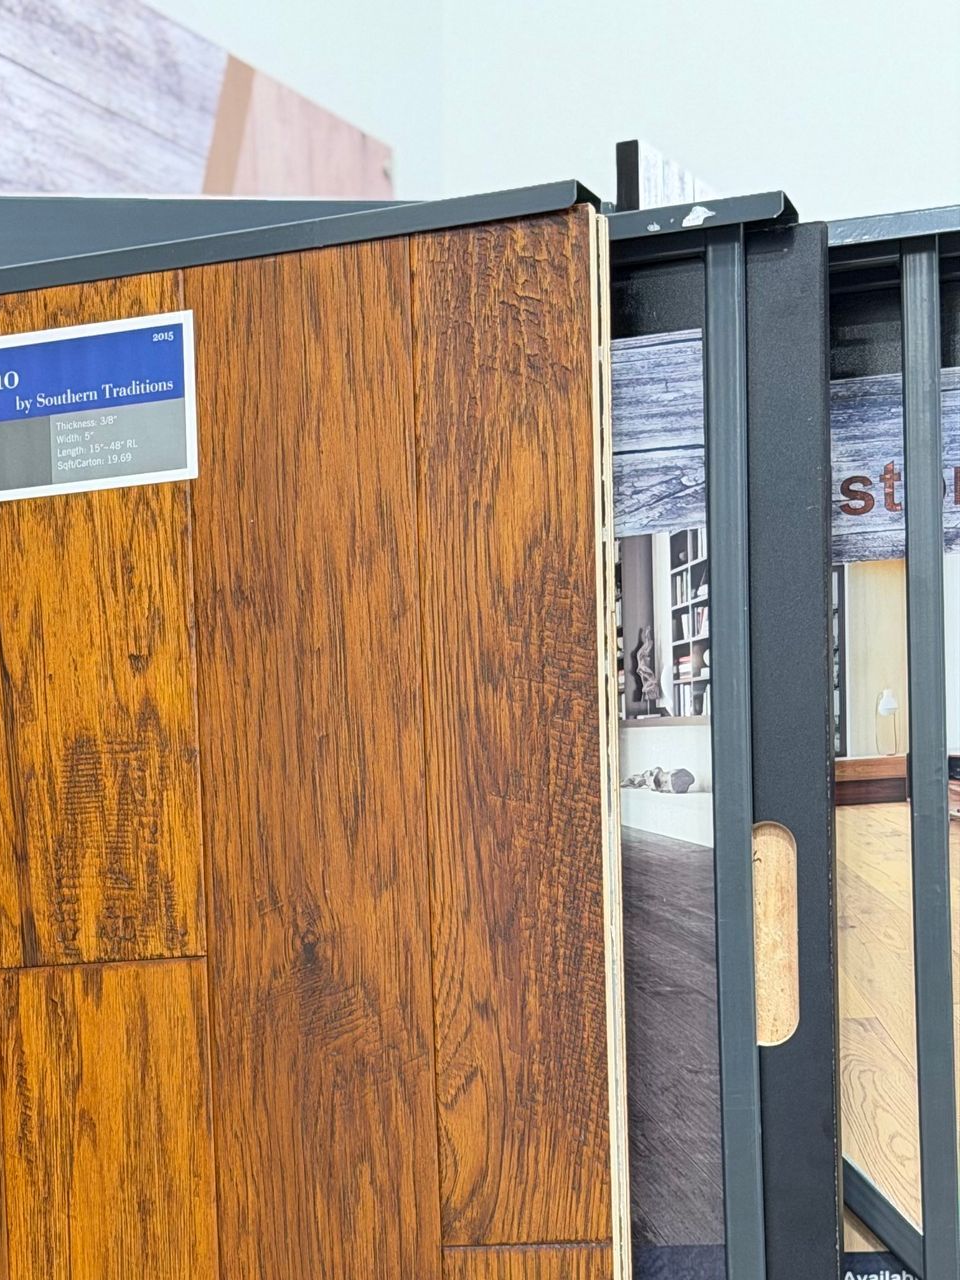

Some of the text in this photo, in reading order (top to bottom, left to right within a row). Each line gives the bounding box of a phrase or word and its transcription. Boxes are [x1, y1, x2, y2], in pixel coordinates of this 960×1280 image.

[152, 331, 174, 343] 2015
[15, 379, 174, 413] by Southern Traditions
[56, 415, 117, 431] Thickness: 3/8"
[56, 431, 94, 444] Width: 5"
[57, 446, 86, 458] Length:
[126, 439, 138, 448] RL
[57, 452, 133, 471] Sqft/Carton: 19.69
